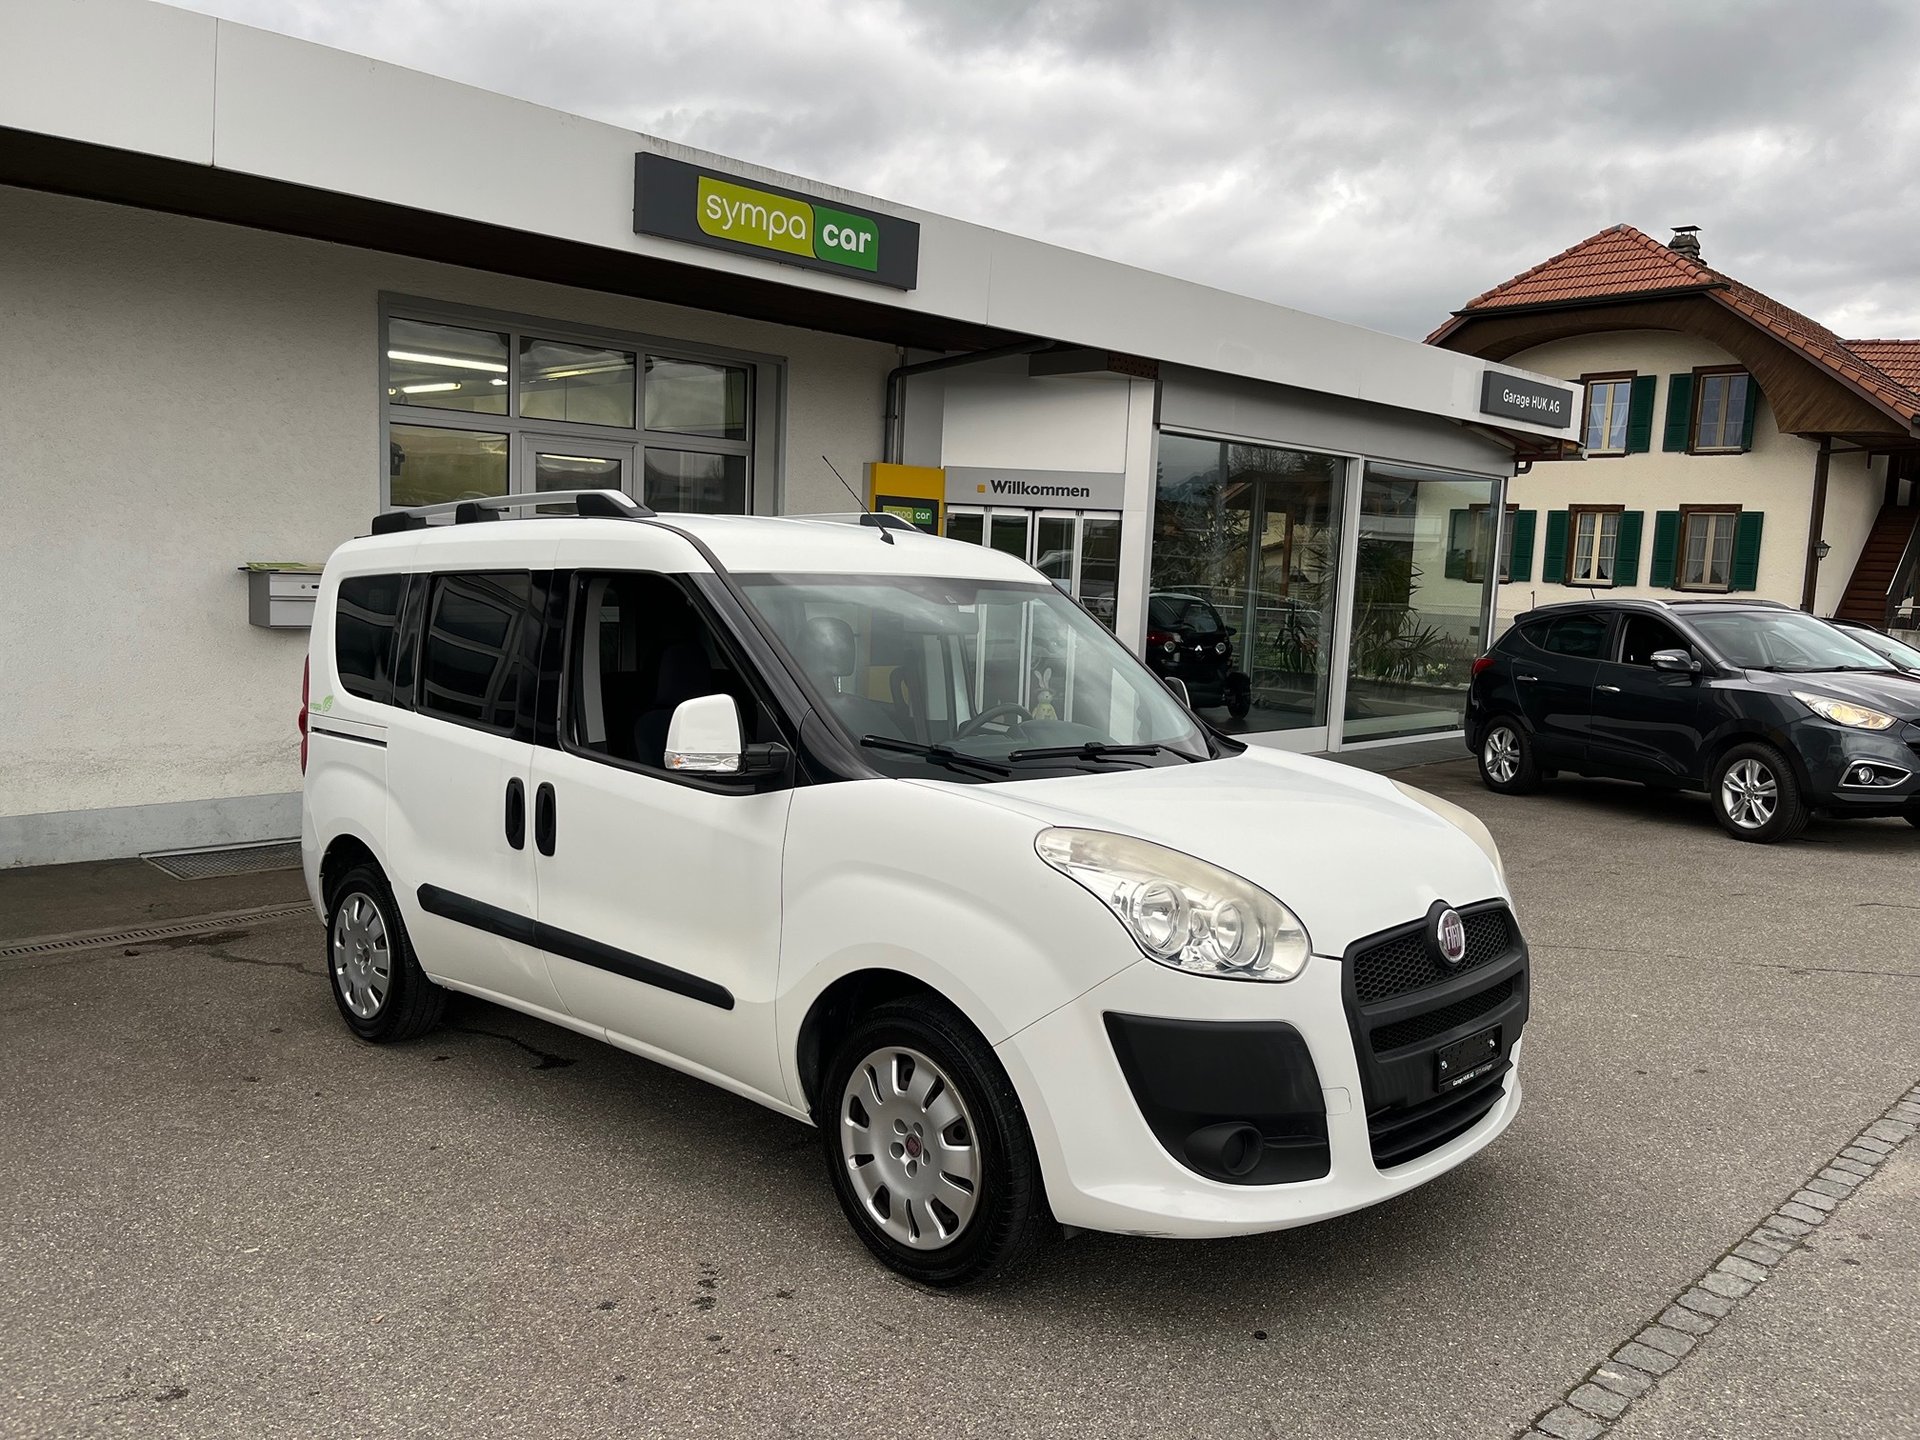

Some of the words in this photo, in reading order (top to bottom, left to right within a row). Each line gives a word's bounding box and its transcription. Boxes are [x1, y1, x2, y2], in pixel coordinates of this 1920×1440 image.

[706, 194, 807, 241] sympa
[822, 223, 872, 253] car
[1503, 388, 1530, 408] Garage
[1531, 395, 1548, 411] HUK
[1548, 399, 1560, 413] AG
[990, 479, 1090, 498] Willkommen
[915, 511, 930, 520] car
[1445, 923, 1461, 951] FIAT
